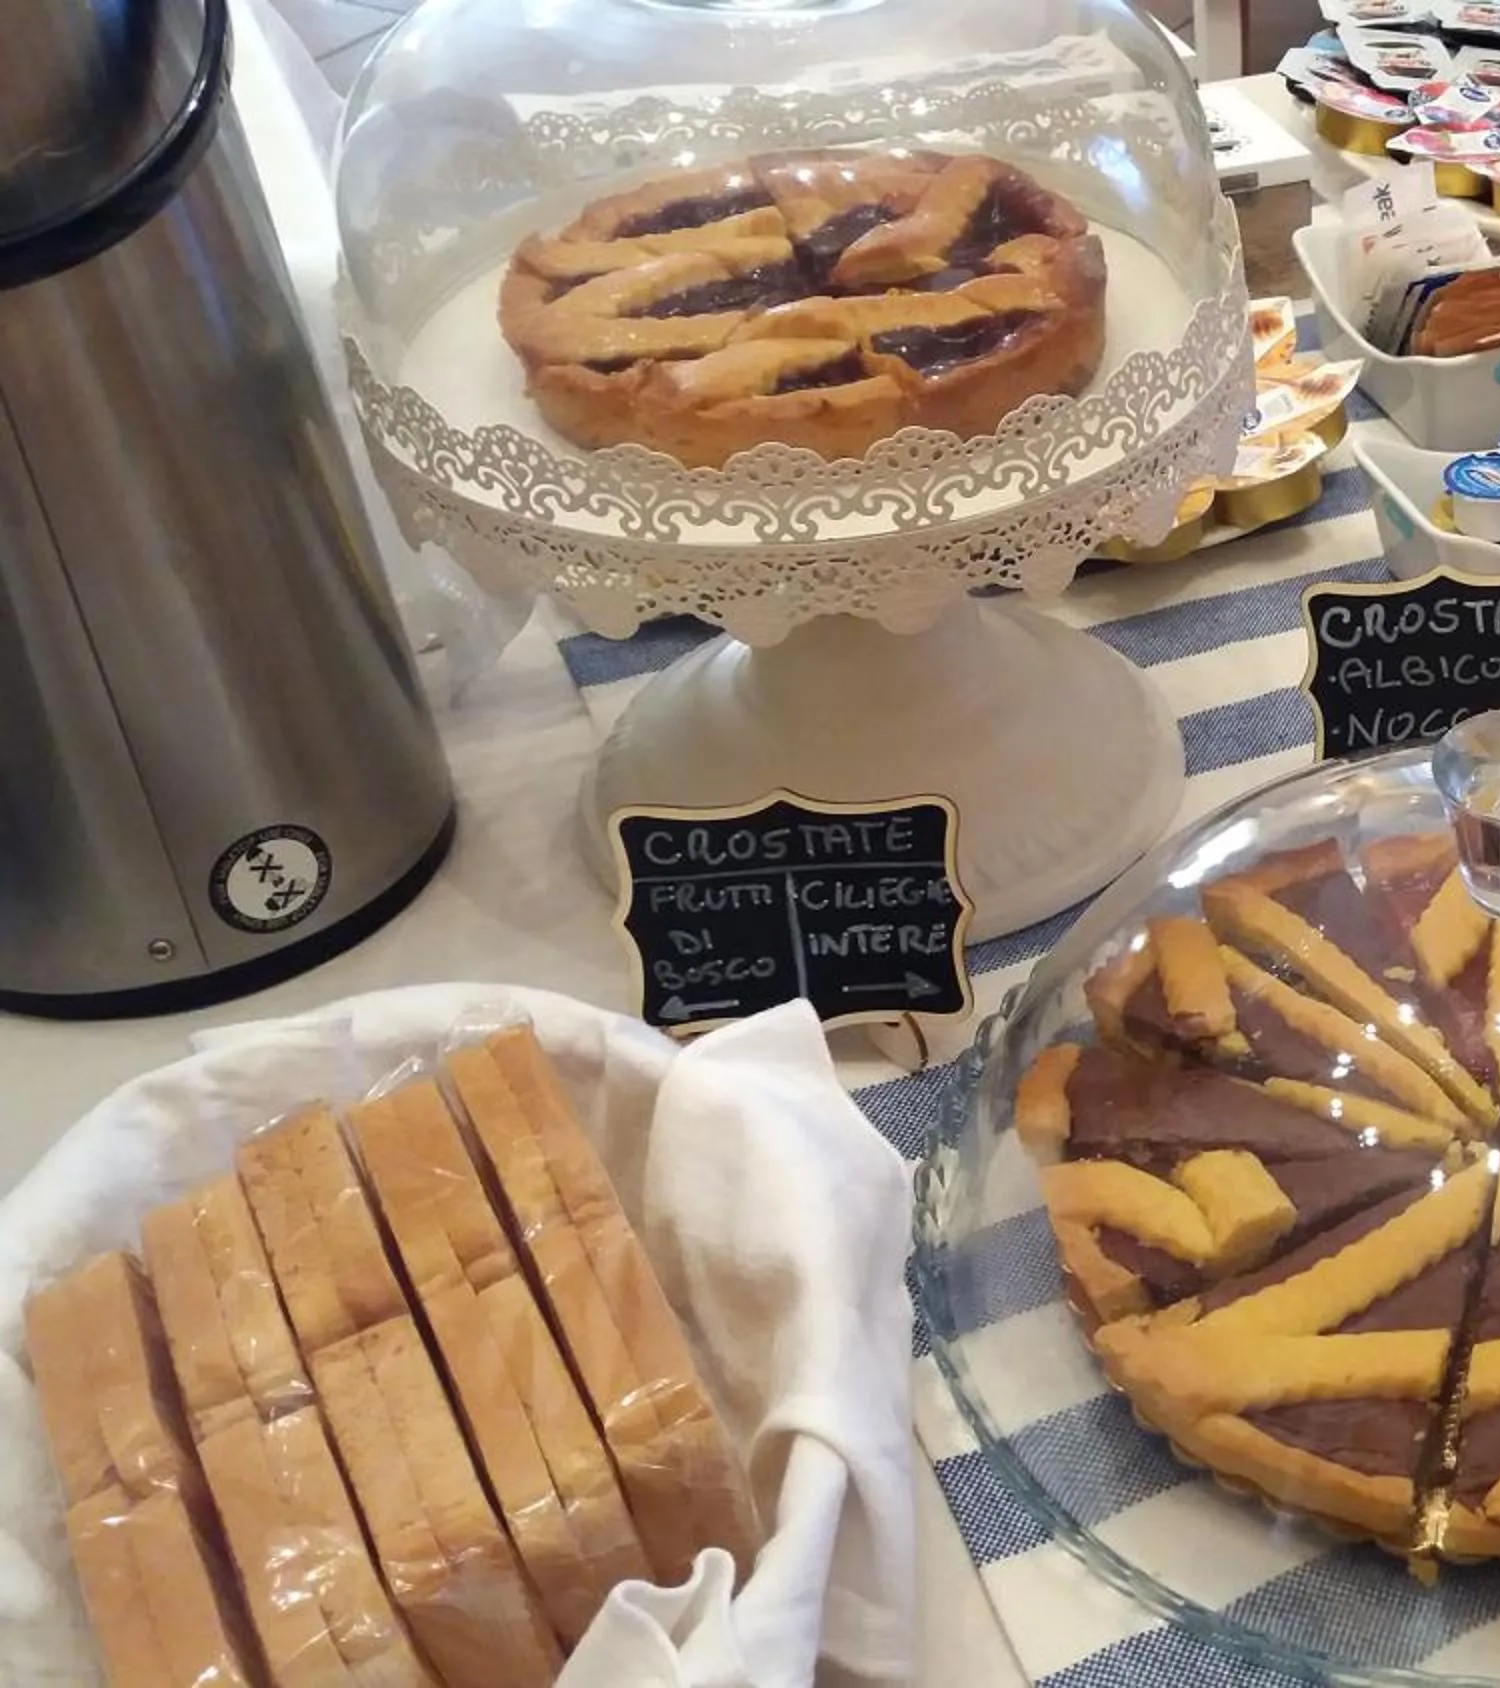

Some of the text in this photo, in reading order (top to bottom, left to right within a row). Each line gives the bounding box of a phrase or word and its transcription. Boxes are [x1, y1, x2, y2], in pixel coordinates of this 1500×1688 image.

[644, 816, 912, 864] CROSTATE
[650, 884, 772, 912] FRUTTI
[668, 928, 712, 953] DI
[809, 923, 946, 957] INTERE
[653, 957, 776, 990] BOSCO
